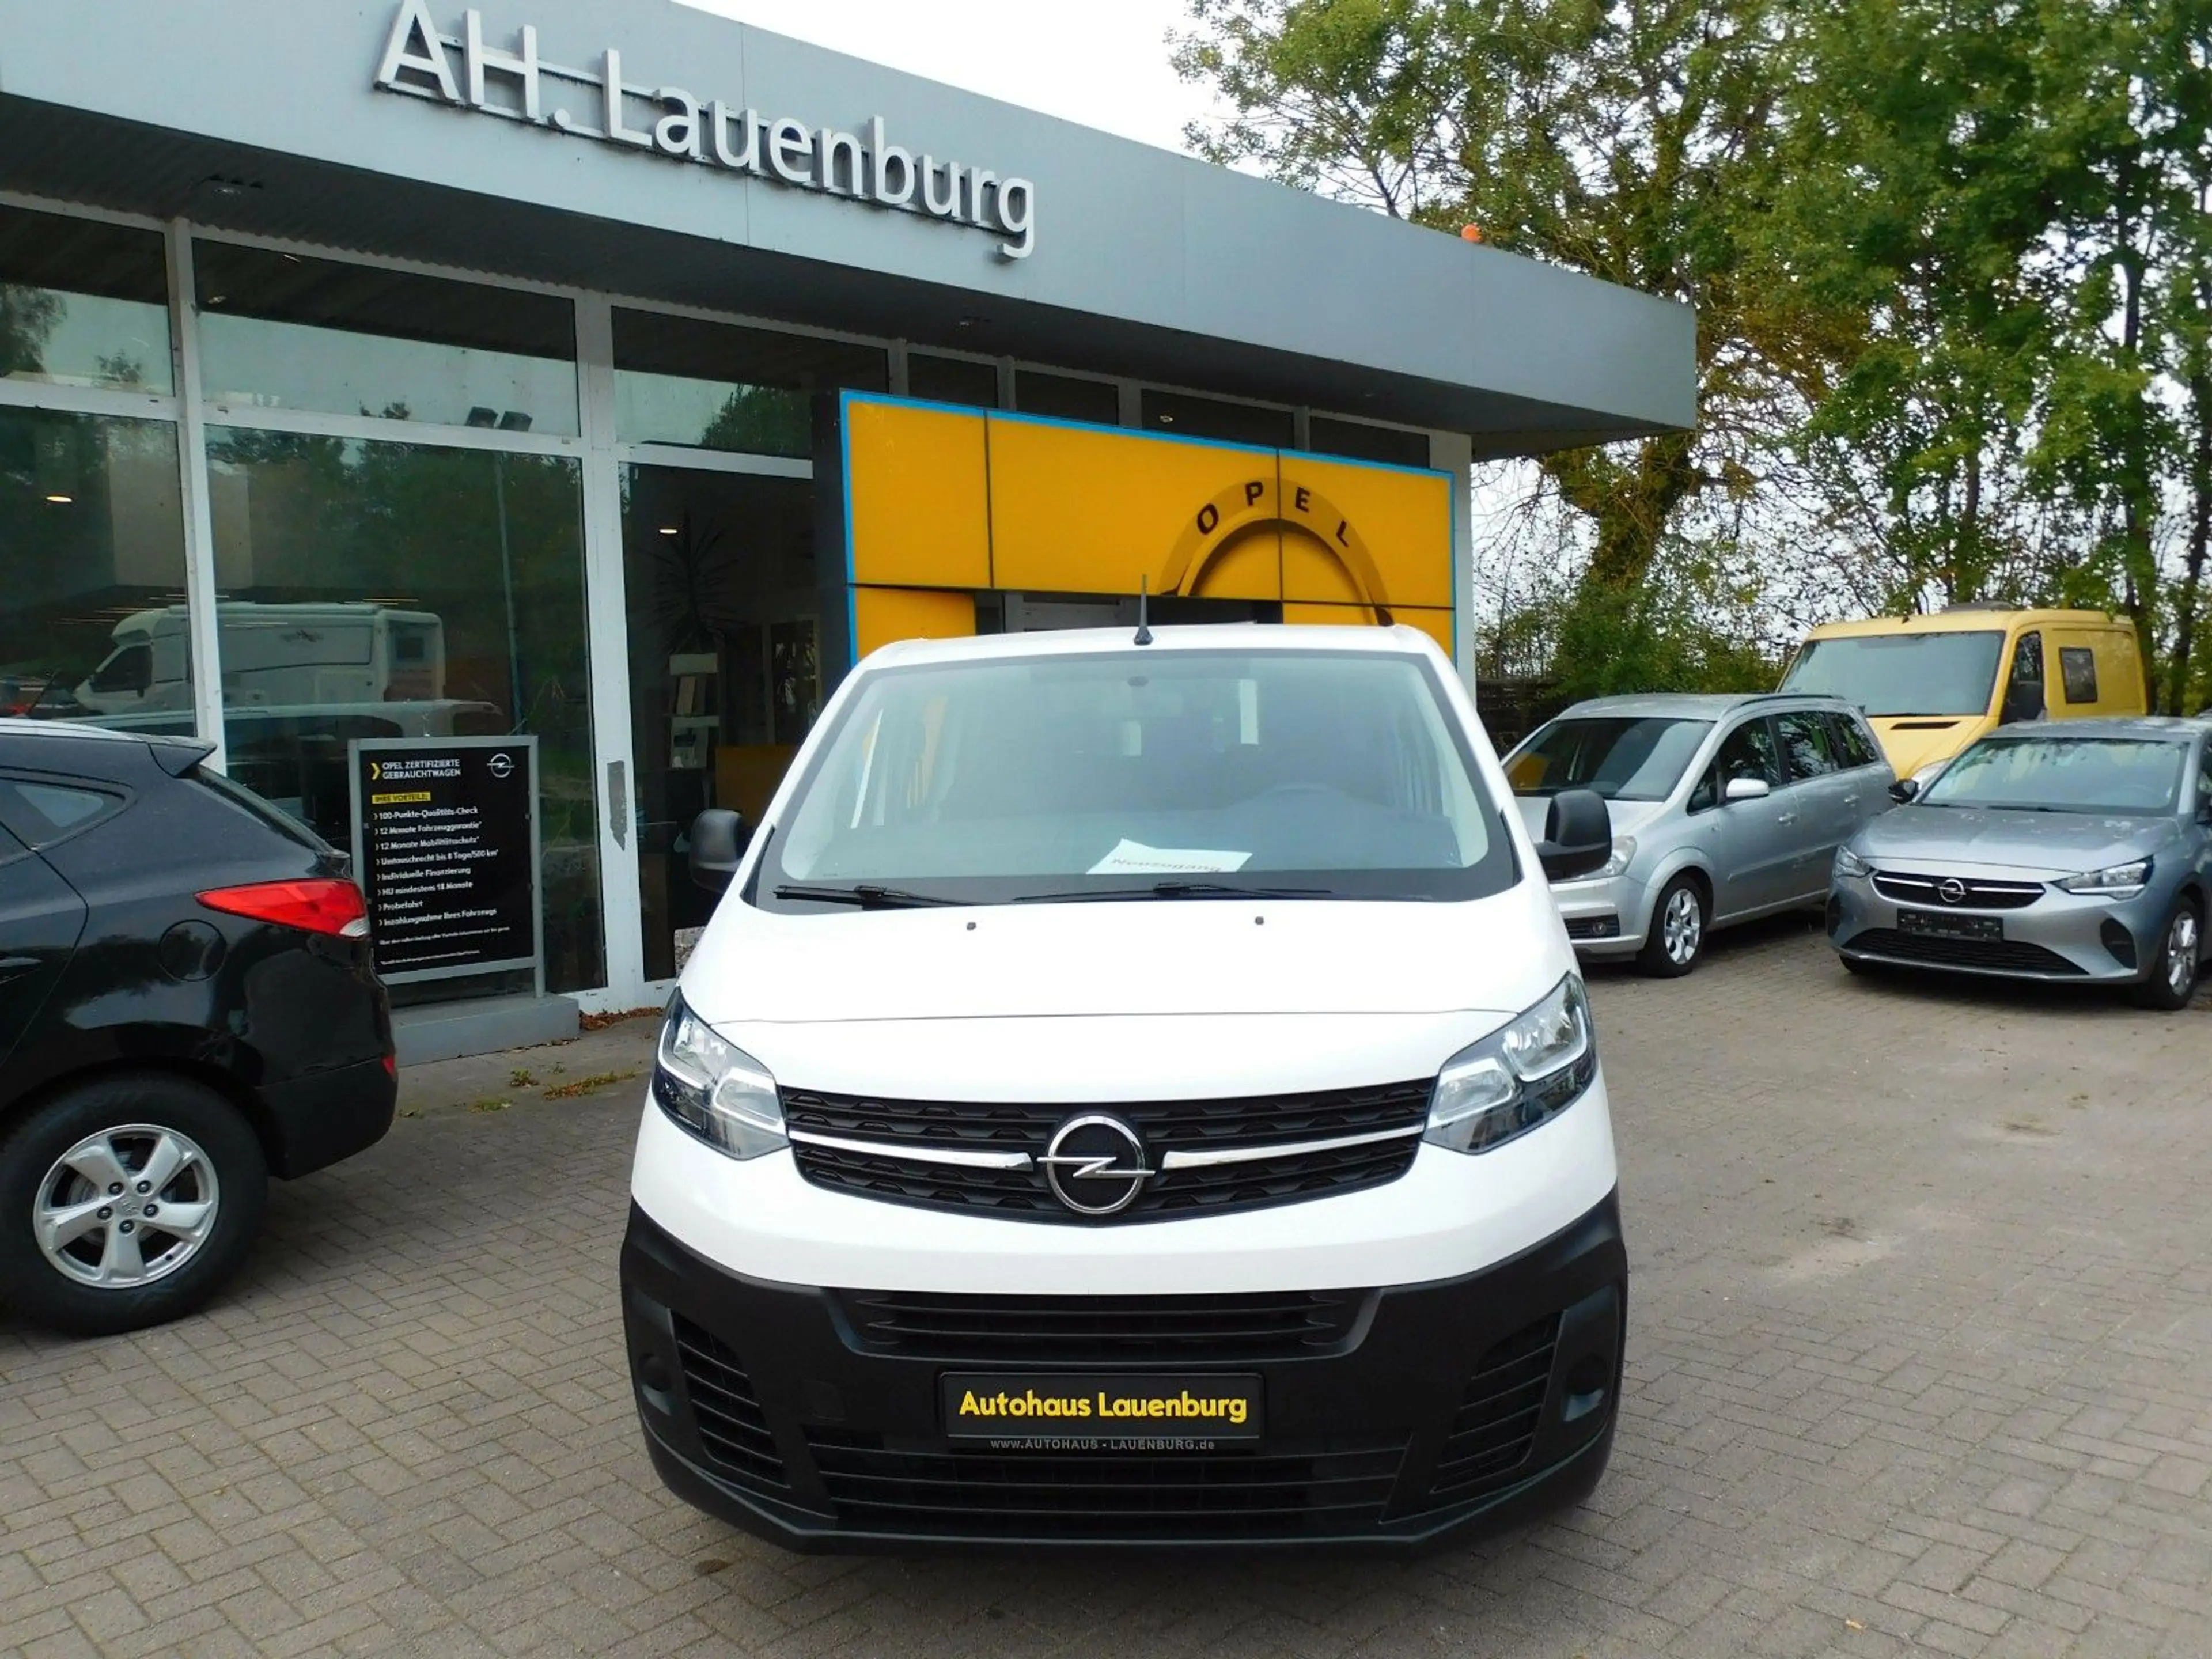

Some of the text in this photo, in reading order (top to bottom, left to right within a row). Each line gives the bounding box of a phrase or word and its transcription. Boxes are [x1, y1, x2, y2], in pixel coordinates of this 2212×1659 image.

[1196, 481, 1349, 547] OPEL
[382, 759, 460, 770] OPEL ZERTIFIZIERTE
[382, 769, 461, 779] GEBRAUCHTWAGEN
[391, 841, 418, 849] Monate
[382, 868, 471, 881] Individuelle Finanzierung
[446, 881, 473, 889] Monate
[384, 900, 423, 910] Probefahrt
[959, 1390, 1247, 1423] Autohaus Lauenburg
